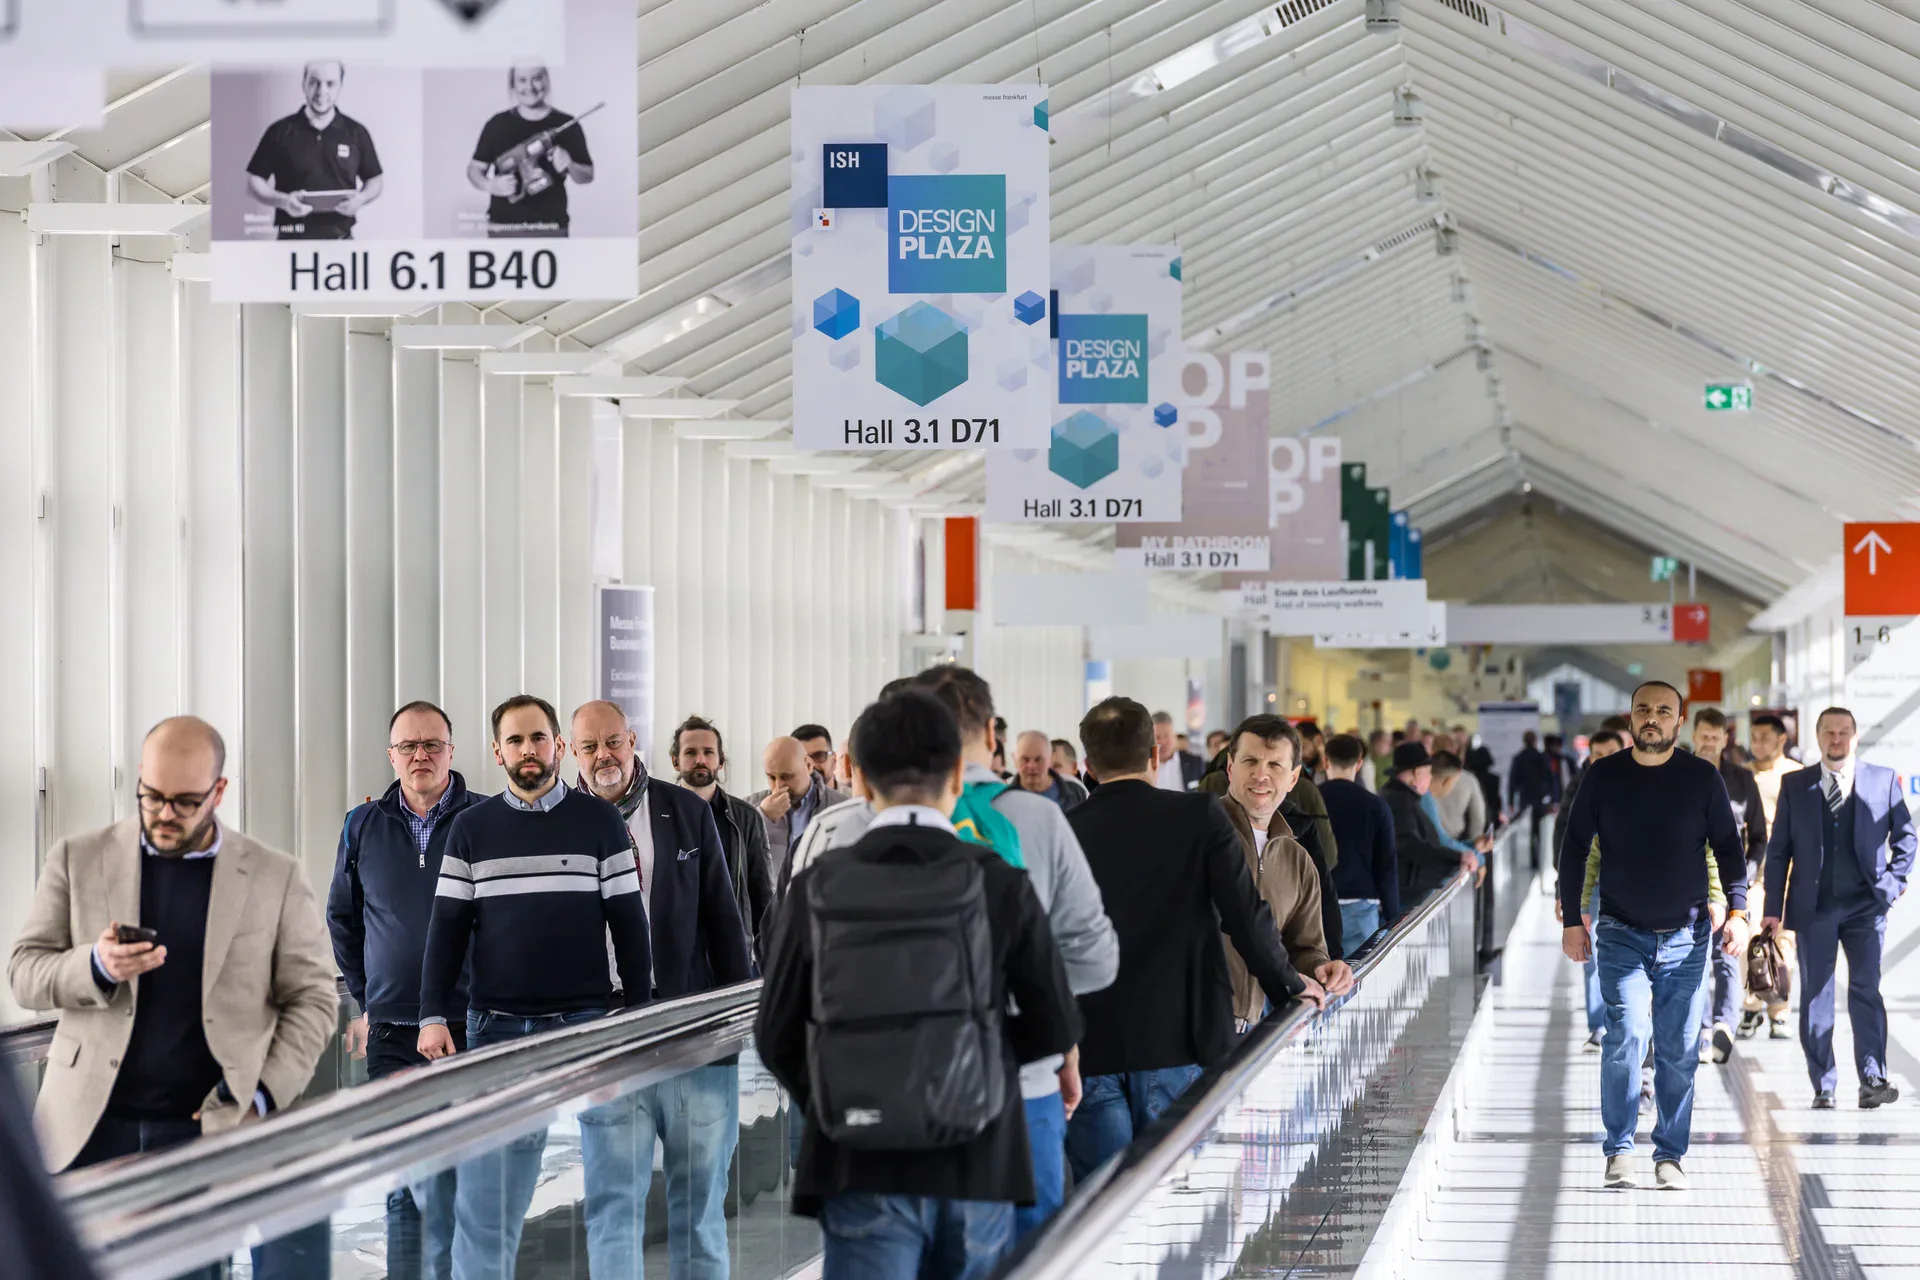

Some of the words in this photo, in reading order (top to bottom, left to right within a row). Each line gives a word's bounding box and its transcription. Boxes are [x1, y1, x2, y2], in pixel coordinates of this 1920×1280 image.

[830, 151, 860, 169] ISH
[898, 208, 996, 234] DESIGN
[898, 235, 995, 260] PLAZA
[290, 251, 370, 291] Hall
[389, 250, 446, 291] 6.1
[467, 249, 558, 290] B40
[1066, 339, 1141, 359] DESIGN
[1066, 359, 1140, 379] PLAZA
[844, 419, 893, 444] Hall
[904, 418, 940, 444] 3.1
[951, 418, 1000, 443] D71
[1024, 499, 1061, 518] Hall
[1069, 498, 1096, 518] 3.1
[1105, 498, 1142, 518] D71
[1141, 535, 1169, 551] MY
[1144, 551, 1177, 568] Hall
[1181, 551, 1204, 568] 3.1
[1209, 551, 1240, 568] D71
